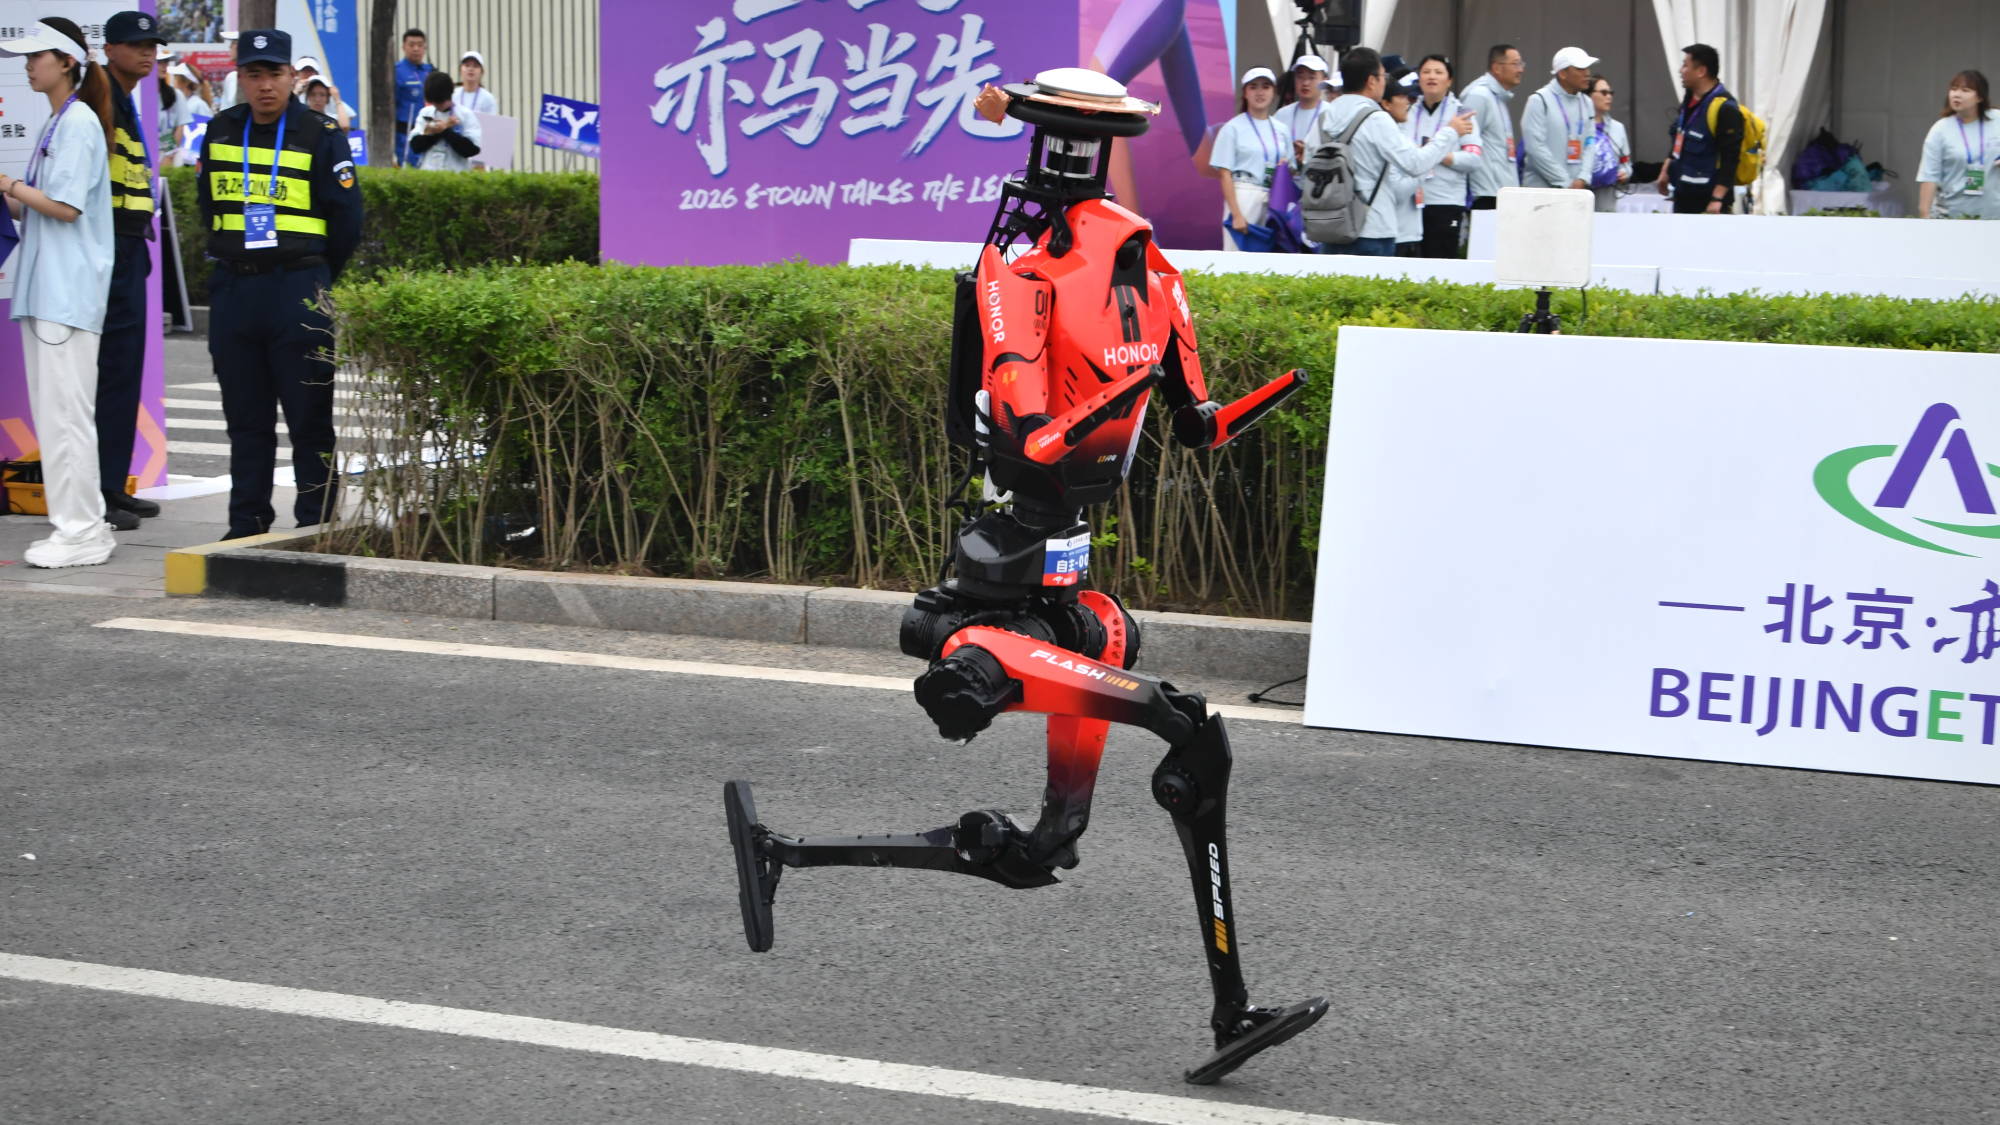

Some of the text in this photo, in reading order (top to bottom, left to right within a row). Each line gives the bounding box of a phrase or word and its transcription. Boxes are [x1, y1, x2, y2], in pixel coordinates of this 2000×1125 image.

[649, 14, 1024, 175] 亦马当先
[679, 187, 738, 210] 2026
[745, 181, 835, 210] E-TOWN
[840, 177, 914, 206] TAKES
[922, 173, 965, 212] THE
[988, 280, 1005, 344] HONOR
[1104, 342, 1159, 366] HONOR
[1030, 649, 1107, 681] FLASH
[1208, 842, 1224, 920] SPEED
